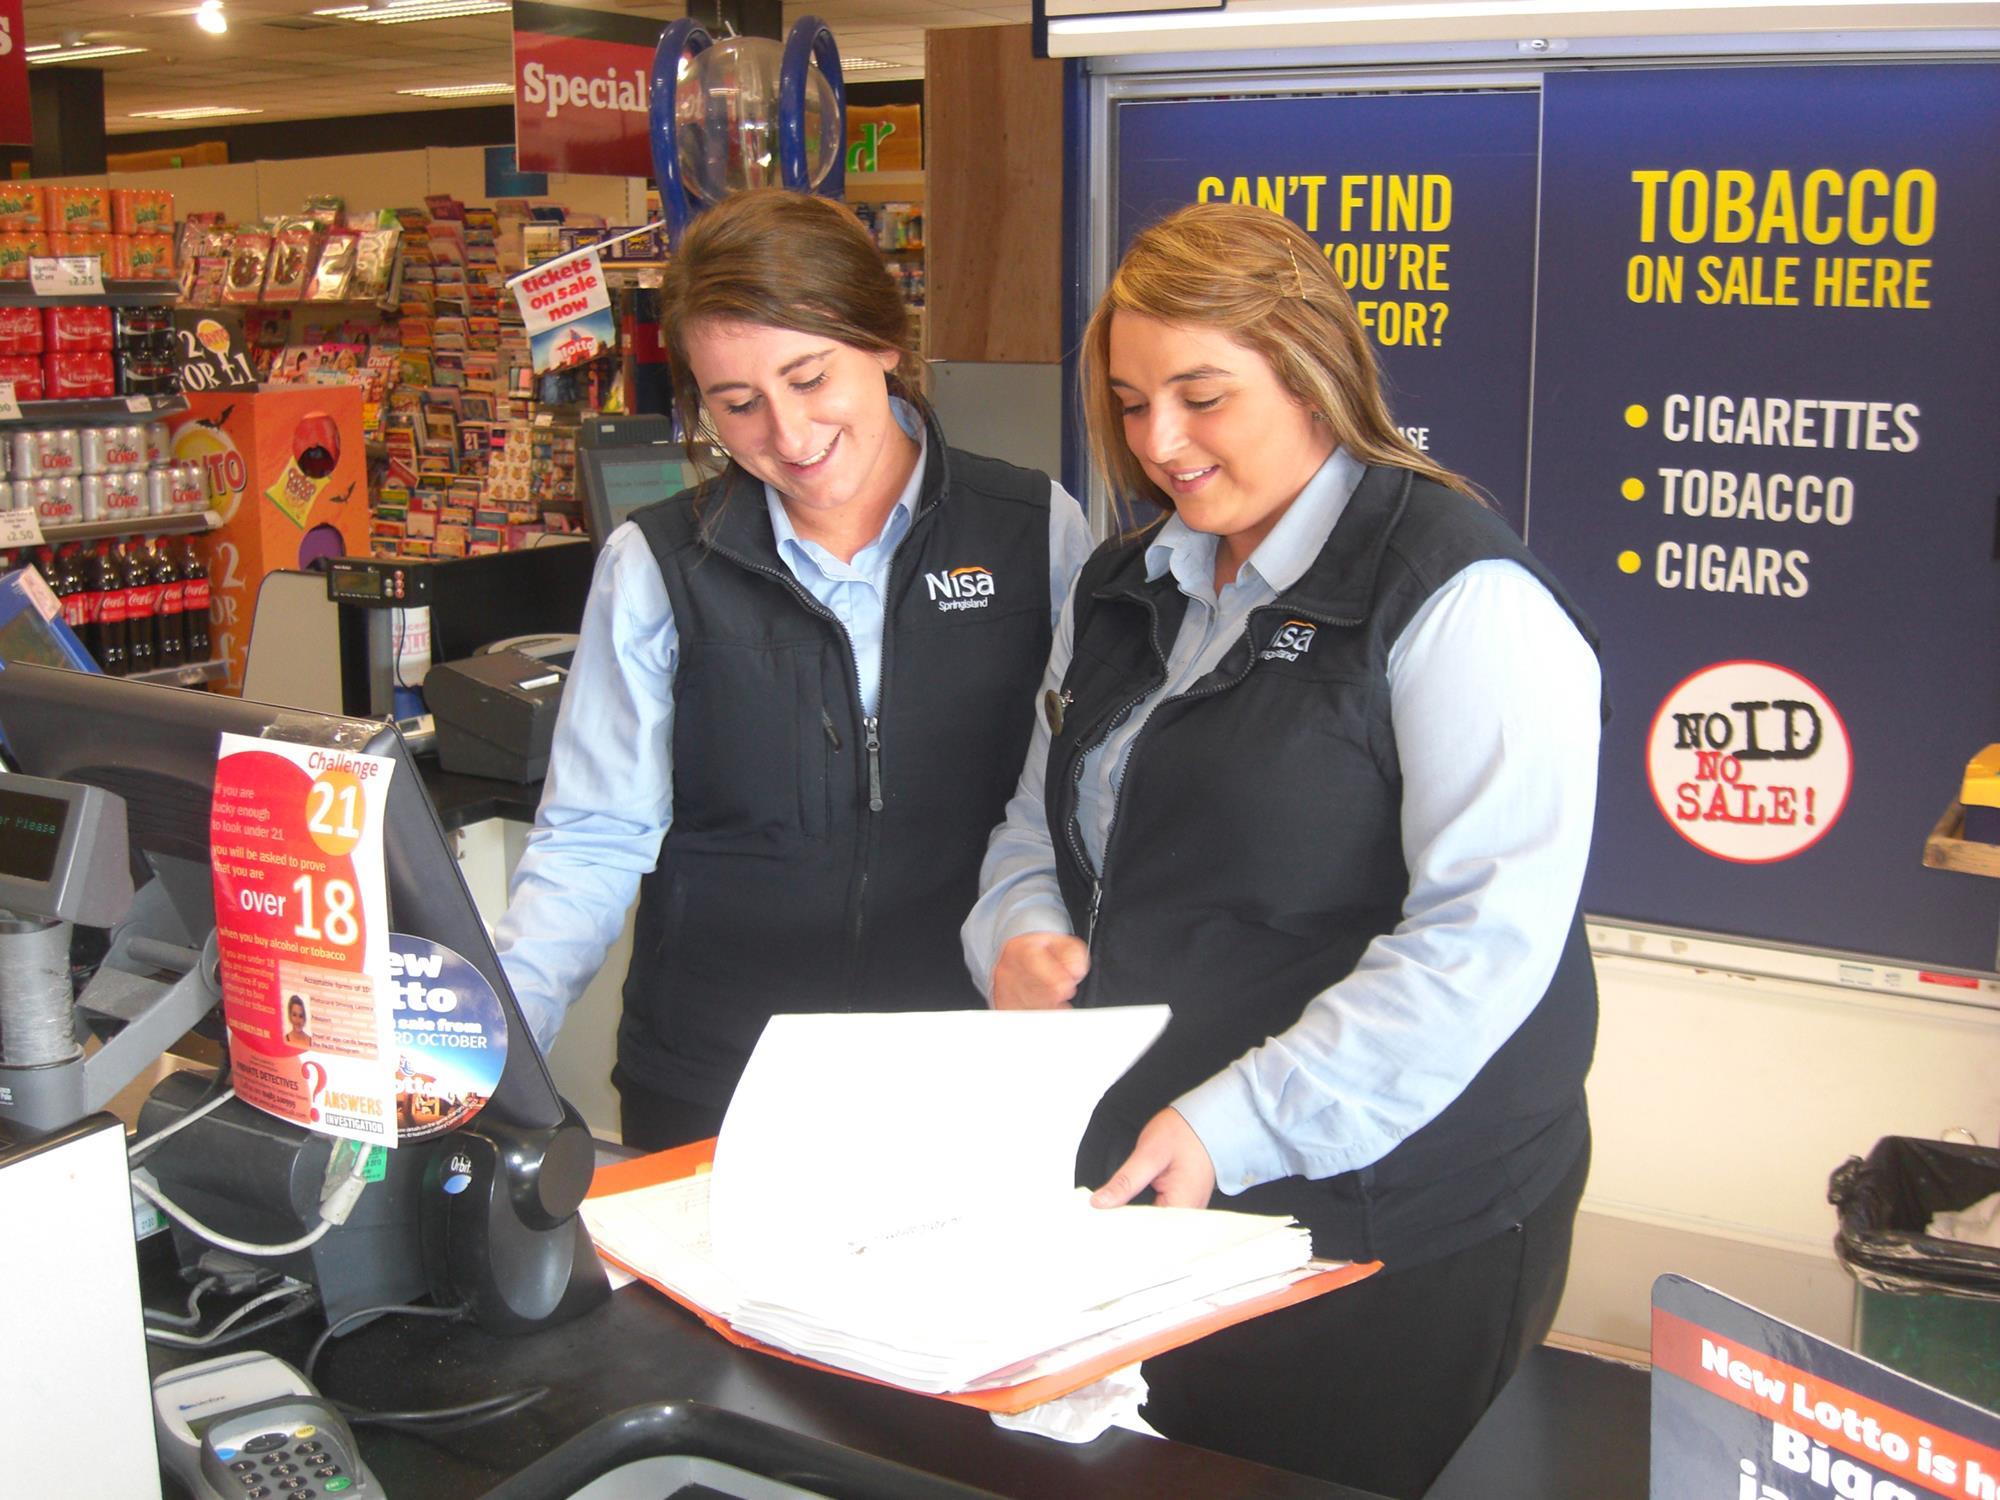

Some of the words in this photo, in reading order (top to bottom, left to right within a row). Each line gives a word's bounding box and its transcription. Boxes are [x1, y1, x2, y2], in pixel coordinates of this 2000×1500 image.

[1340, 174, 1453, 233] FIND
[1631, 168, 1937, 246] TOBACCO
[521, 257, 592, 293] tickets
[1626, 254, 1684, 304] ON
[1696, 255, 1800, 306] SALE
[1813, 257, 1932, 309] HERE
[530, 291, 556, 310] on
[558, 274, 598, 301] sale
[548, 297, 589, 322] now
[177, 330, 205, 359] 2
[1663, 394, 1921, 453] CIGARETTES
[42, 453, 73, 469] Coke
[106, 447, 138, 465] Coke
[40, 500, 73, 516] Coke
[107, 492, 139, 508] Coke
[1658, 468, 1854, 526] TOBACCO
[1655, 541, 1810, 598] CIGARS
[924, 570, 995, 601] Nisa
[1672, 712, 1733, 750] NO
[1731, 700, 1822, 761] ID
[308, 751, 379, 780] Challenge
[1694, 751, 1742, 784] NO
[223, 786, 239, 798] you
[240, 788, 255, 799] are
[1676, 783, 1815, 826] SALE!
[237, 806, 270, 822] enough
[309, 781, 360, 839] 21
[16, 816, 55, 834] Please
[223, 821, 242, 834] look
[243, 825, 270, 839] under
[212, 844, 228, 857] you
[229, 846, 245, 857] will
[246, 849, 258, 861] be
[259, 852, 287, 866] asked
[288, 855, 299, 868] to
[300, 859, 326, 873] prove
[214, 859, 231, 874] that
[232, 863, 248, 878] you
[249, 868, 265, 880] are
[240, 888, 287, 918] over
[293, 873, 359, 946] 18
[239, 933, 254, 945] you
[254, 935, 269, 949] buy
[270, 939, 299, 953] alcohol
[300, 947, 310, 956] or
[310, 948, 346, 962] tobacco
[436, 1018, 482, 1034] from
[416, 1033, 487, 1049] OCTOBER
[259, 1070, 299, 1091] DETECTIVES
[324, 1090, 384, 1117] ANSWERS
[326, 1113, 384, 1134] INVESTIGATION
[1701, 1338, 1786, 1405] New
[1792, 1382, 1909, 1462] Lotto
[1917, 1436, 1957, 1484] is
